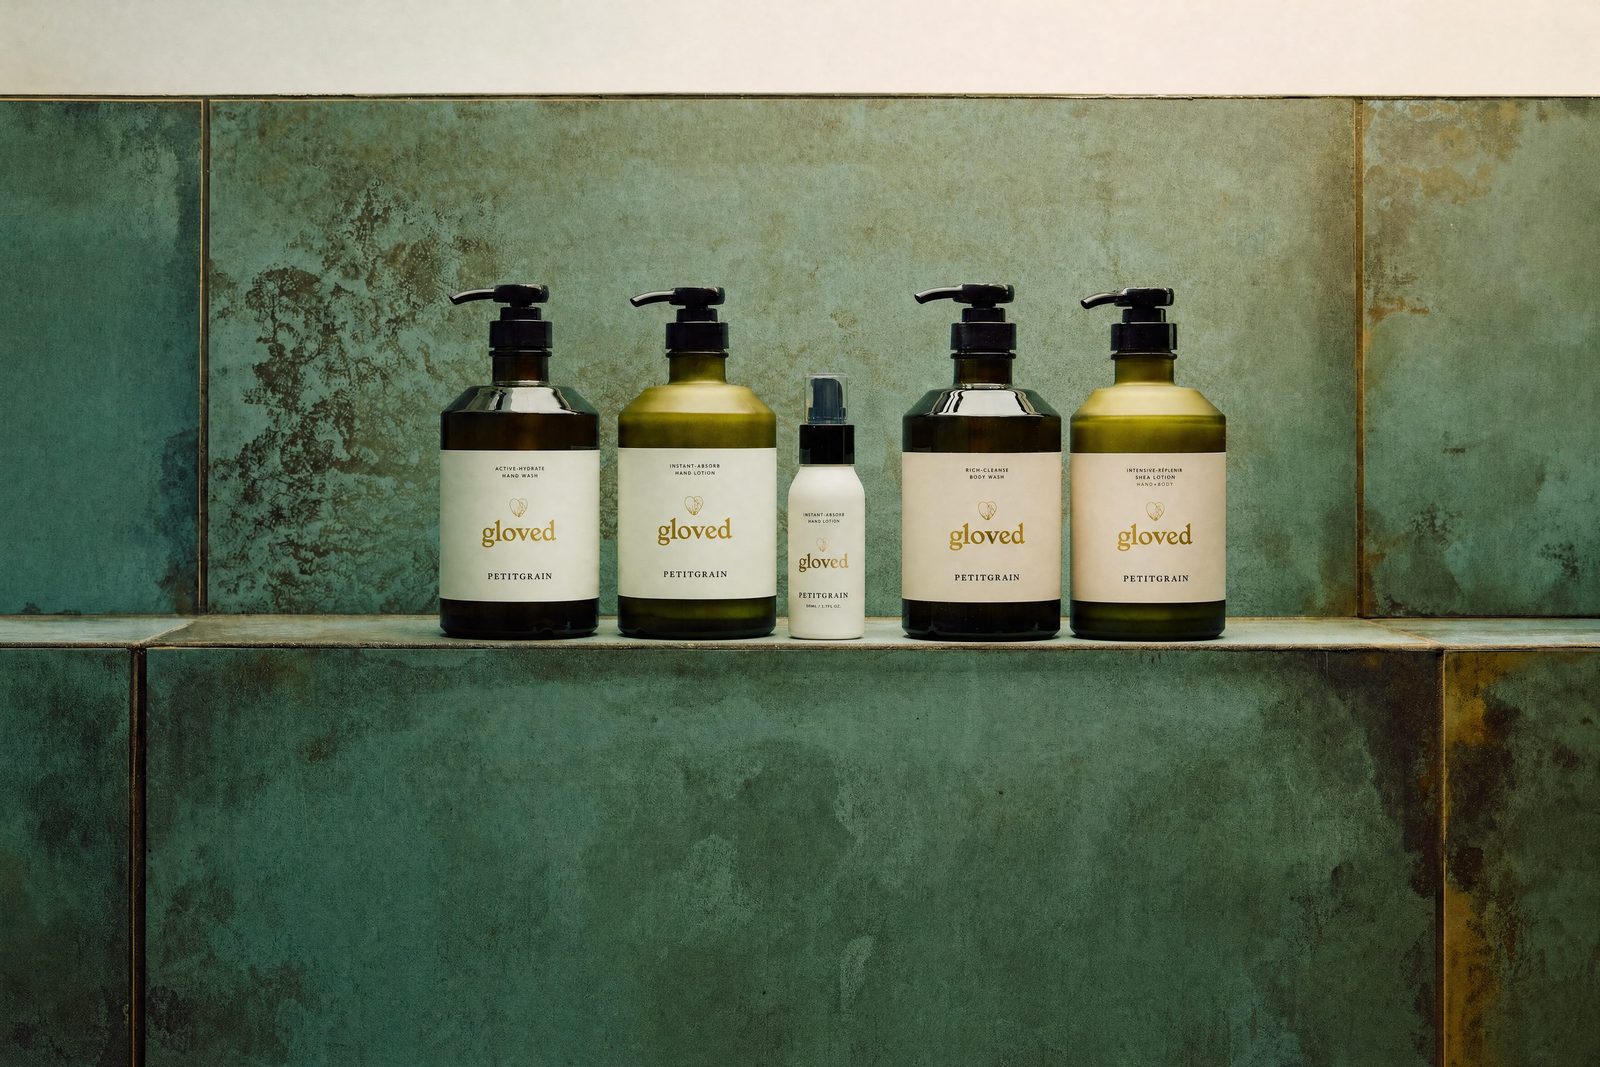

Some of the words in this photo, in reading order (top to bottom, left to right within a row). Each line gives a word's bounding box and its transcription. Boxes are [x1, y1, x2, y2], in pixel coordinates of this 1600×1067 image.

[481, 519, 557, 548] gloved
[657, 517, 733, 547] gloved
[949, 522, 1026, 551] gloved
[1117, 523, 1193, 552] gloved
[798, 553, 849, 573] gloved
[487, 572, 553, 580] PETITGRAIN
[663, 570, 728, 578] PETITGRAIN
[954, 573, 1021, 581] PETITGRAIN
[1122, 574, 1189, 582] PETITGRAIN
